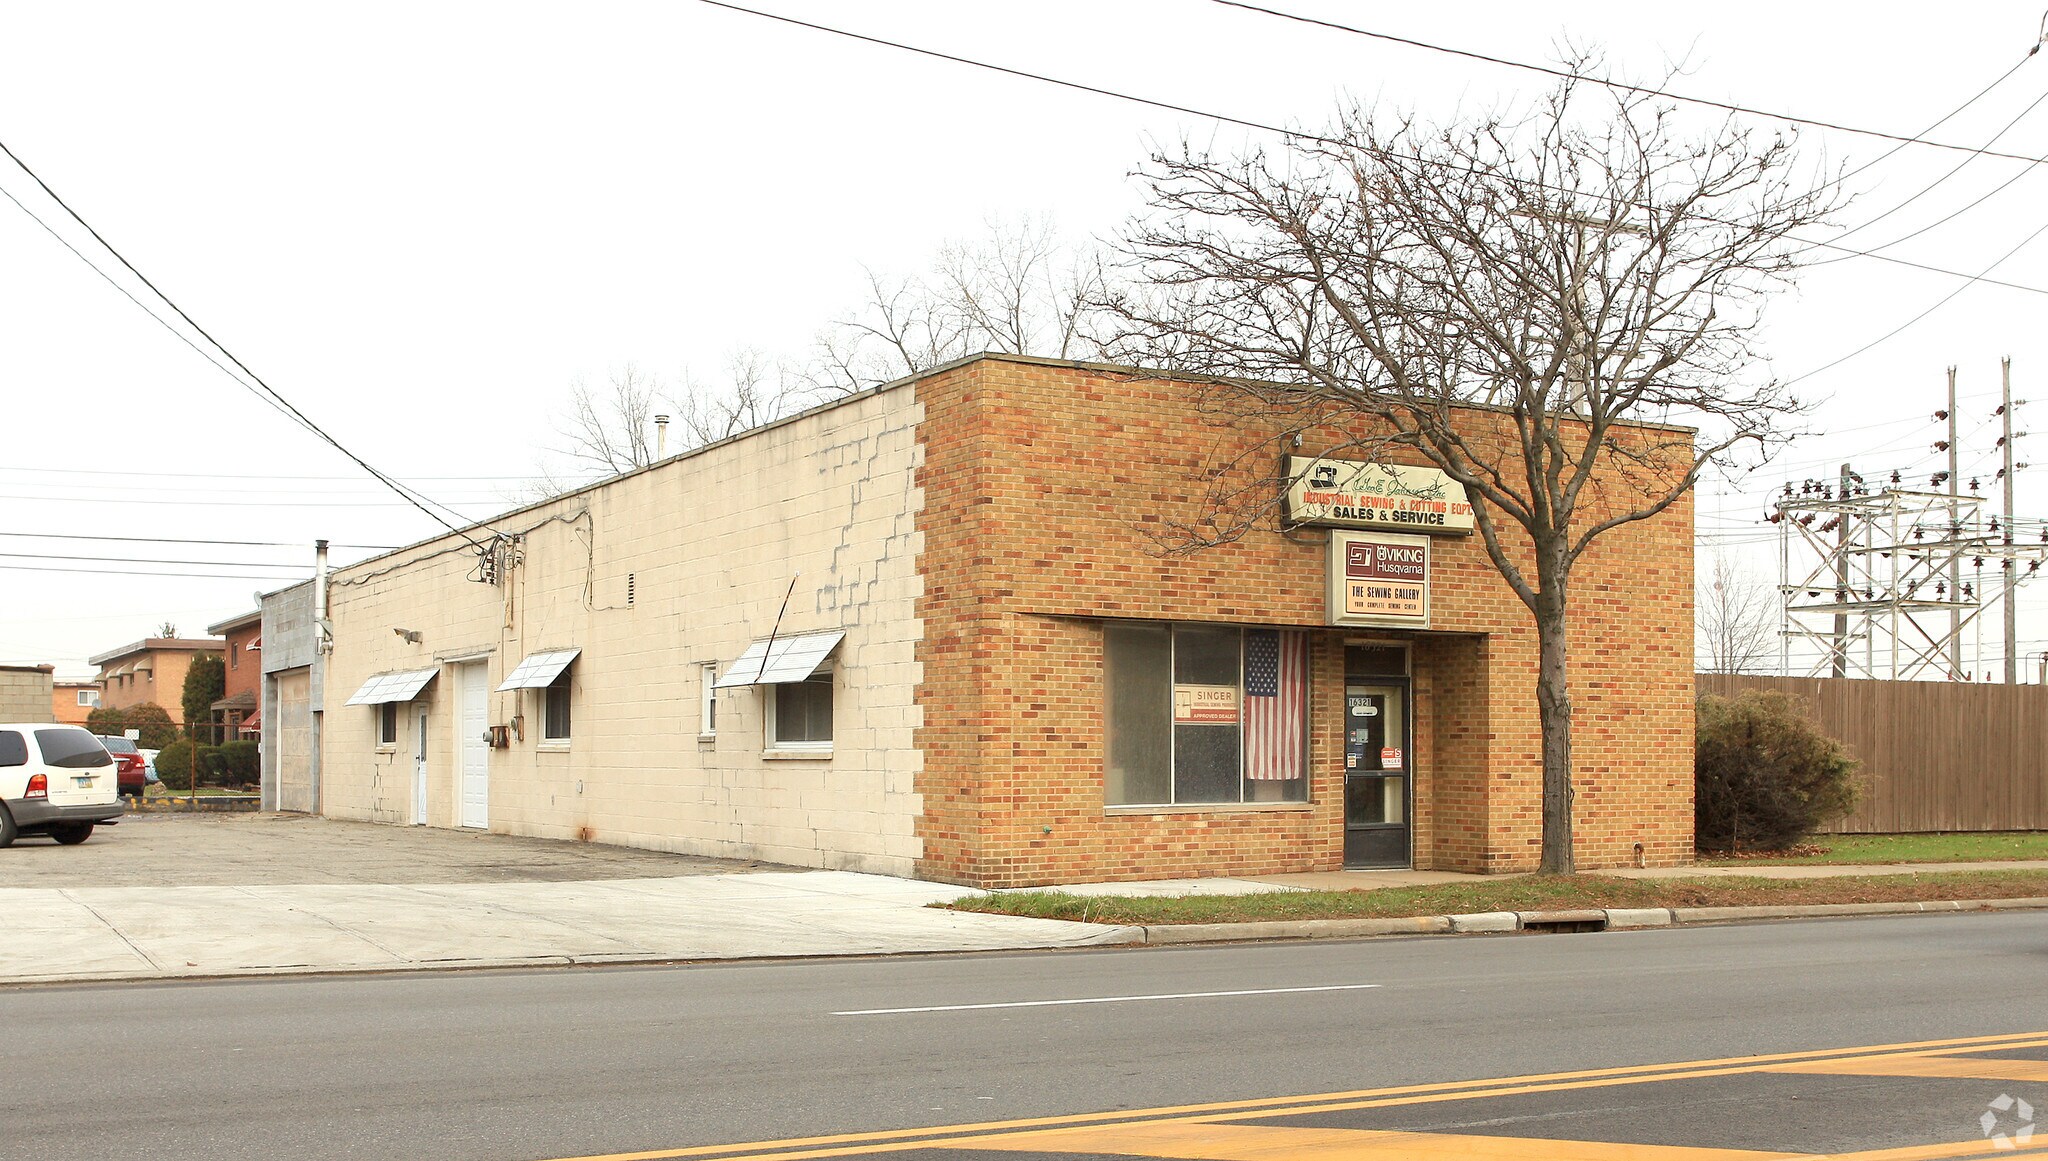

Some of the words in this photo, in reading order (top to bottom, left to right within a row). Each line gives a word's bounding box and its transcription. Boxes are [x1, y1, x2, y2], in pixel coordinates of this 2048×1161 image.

[1304, 491, 1355, 507] INDUSTRIAL
[1360, 495, 1395, 509] SEWING
[1399, 499, 1406, 510] &
[1410, 499, 1447, 513] CUTTING
[1333, 506, 1374, 520] SALES
[1380, 510, 1388, 521] &
[1392, 510, 1445, 525] SERVICE
[1386, 548, 1423, 563] VIKING
[1377, 561, 1423, 575] Husqvarna
[1352, 586, 1364, 597] THE
[1367, 586, 1391, 598] SEWING
[1395, 588, 1420, 600] GALLERY
[1197, 691, 1232, 700] SINGER
[1349, 698, 1370, 706] 16321
